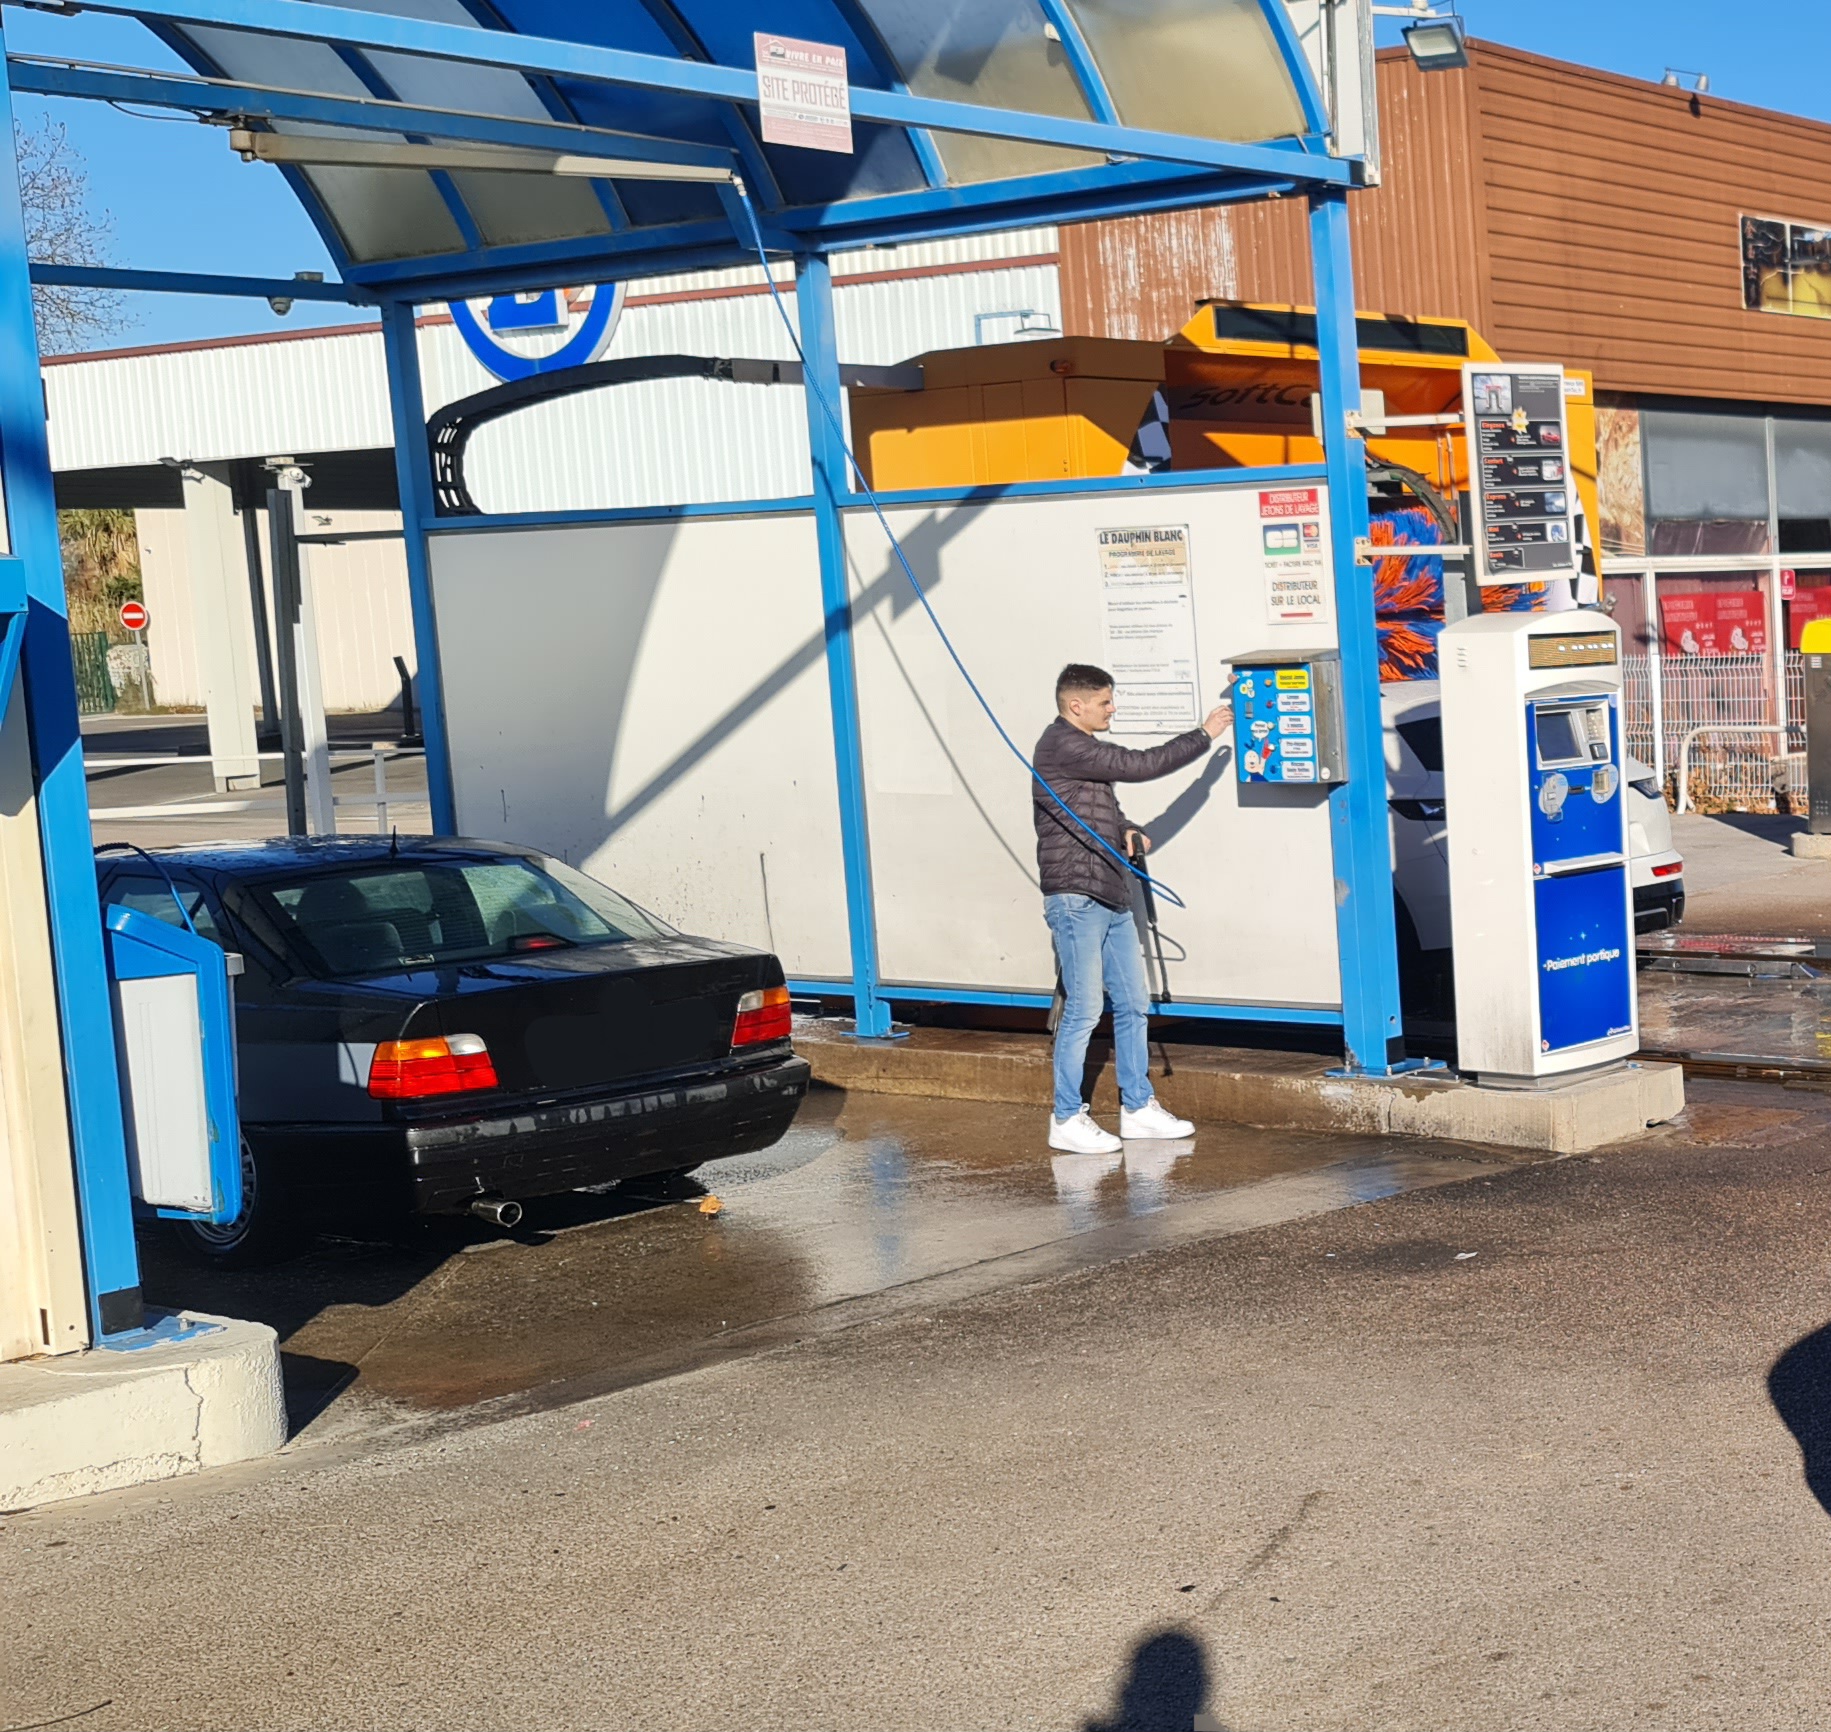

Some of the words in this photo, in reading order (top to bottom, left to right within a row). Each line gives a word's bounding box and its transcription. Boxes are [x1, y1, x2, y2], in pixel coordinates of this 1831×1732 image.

[762, 75, 789, 101] SITE
[792, 79, 847, 109] PROTÉGÉ
[1099, 531, 1109, 544] LE
[1111, 530, 1151, 544] DAUPHIN
[1153, 529, 1183, 542] BLANC
[1286, 595, 1294, 605] LE
[1297, 594, 1321, 605] LOCAL
[1586, 948, 1620, 966] portique
